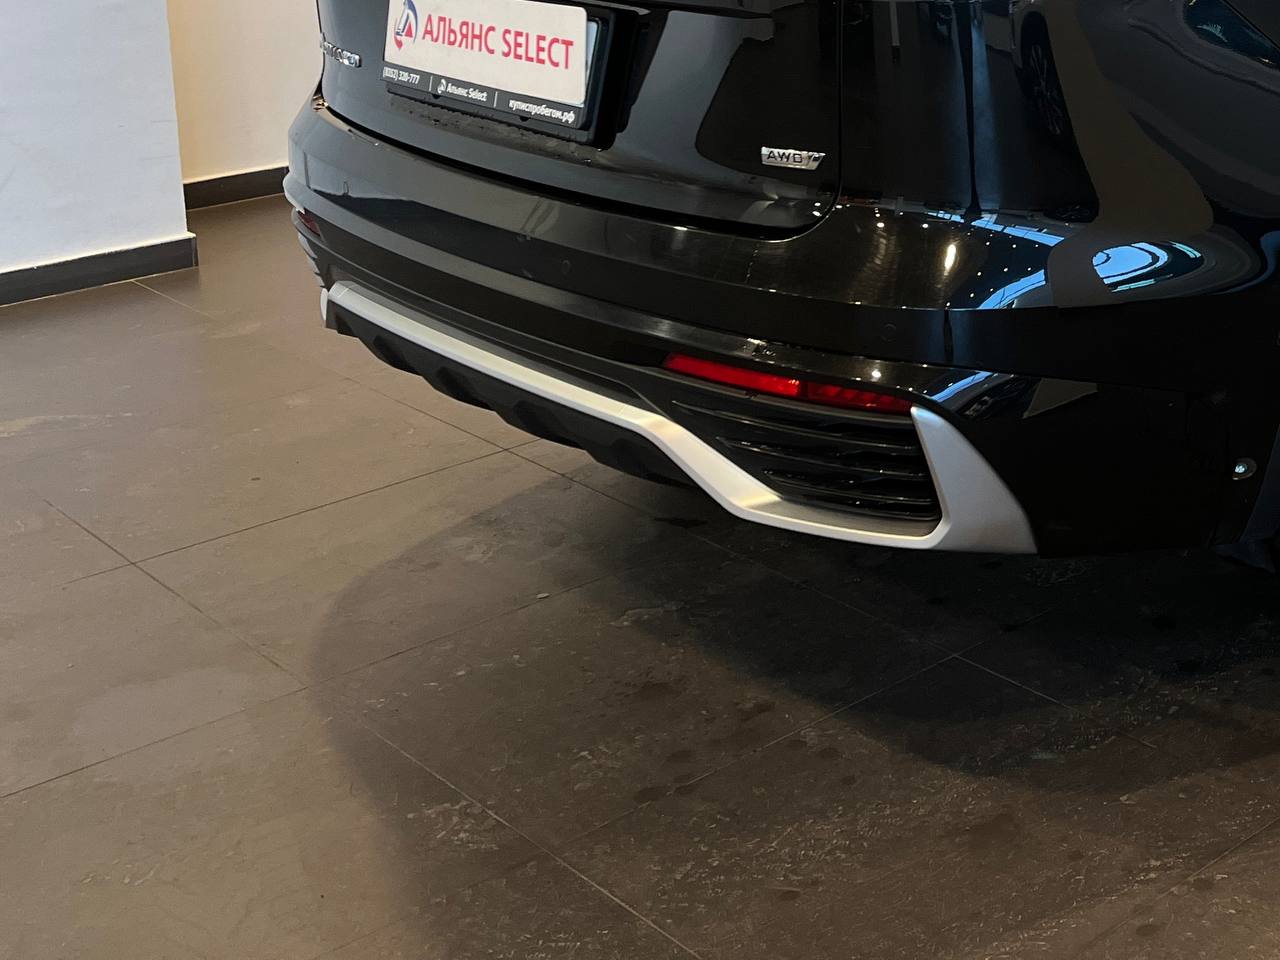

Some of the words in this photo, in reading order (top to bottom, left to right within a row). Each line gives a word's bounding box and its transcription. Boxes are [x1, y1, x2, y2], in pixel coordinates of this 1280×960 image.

[421, 13, 496, 55] АЛЬЯНС
[501, 28, 575, 70] SELECT
[446, 83, 469, 98] Альянс
[468, 87, 488, 102] Select
[508, 99, 576, 124] куписпробегом.рф
[767, 150, 803, 164] AWD
